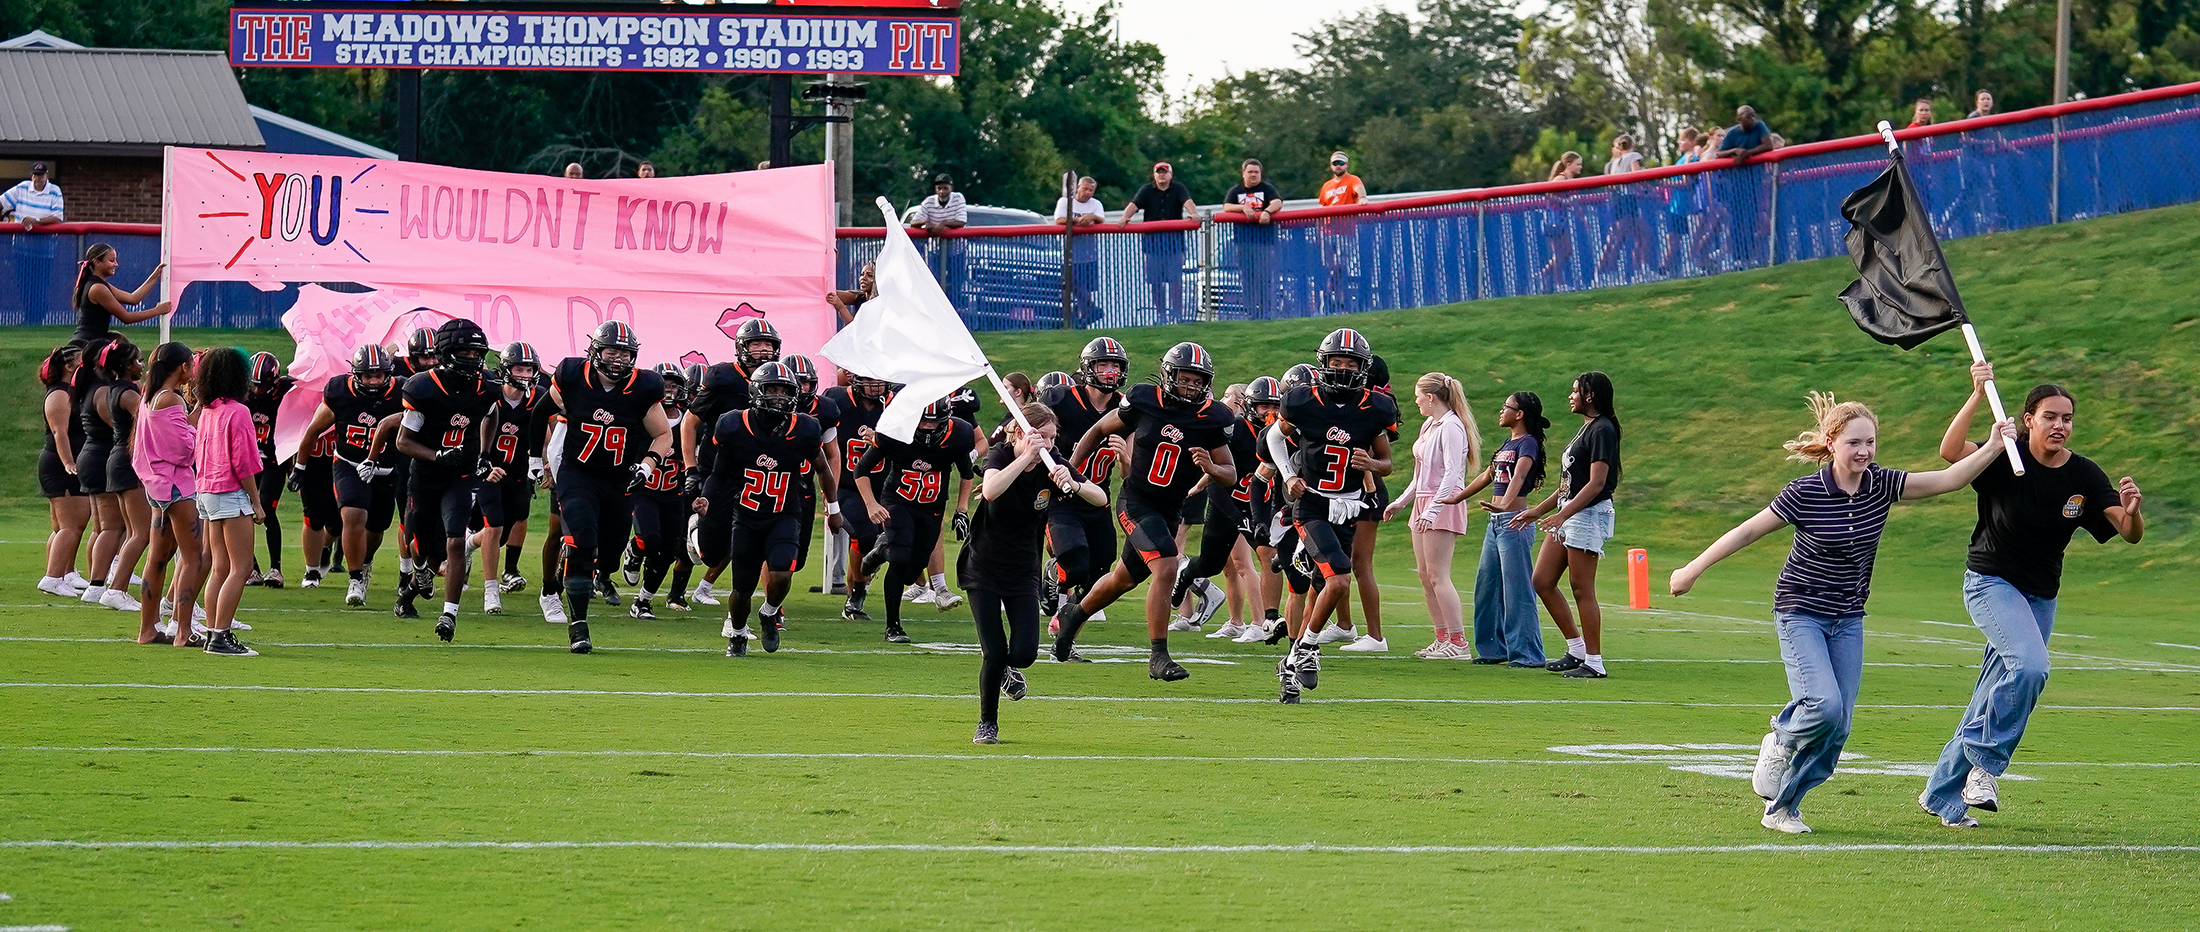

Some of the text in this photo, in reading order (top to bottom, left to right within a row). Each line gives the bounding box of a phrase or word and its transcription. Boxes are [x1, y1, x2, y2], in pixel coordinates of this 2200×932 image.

[238, 15, 312, 62] THE
[323, 13, 878, 48] MEADOWS THOMPSON STADIUM
[335, 43, 413, 64] STATE
[418, 44, 622, 67] CHAMPIONSHIPS
[642, 47, 700, 68] 1982
[724, 48, 781, 69] 1990
[805, 50, 864, 70] 1993
[889, 23, 952, 70] PIT
[253, 173, 729, 254] YOU WOULDNT KNOW
[464, 294, 522, 345] TO
[358, 411, 377, 426] City
[450, 413, 470, 428] City
[501, 421, 519, 435] City
[593, 408, 615, 425] City
[577, 422, 628, 467] 79
[1161, 424, 1184, 443] City
[1326, 426, 1351, 445] City
[496, 434, 519, 464] 9
[756, 453, 778, 470] City
[1147, 441, 1182, 487] 0
[911, 459, 932, 471] City
[1317, 444, 1351, 492] 3
[739, 467, 791, 513] 24
[895, 468, 942, 504] 58
[1118, 510, 1137, 536] TIGERS
